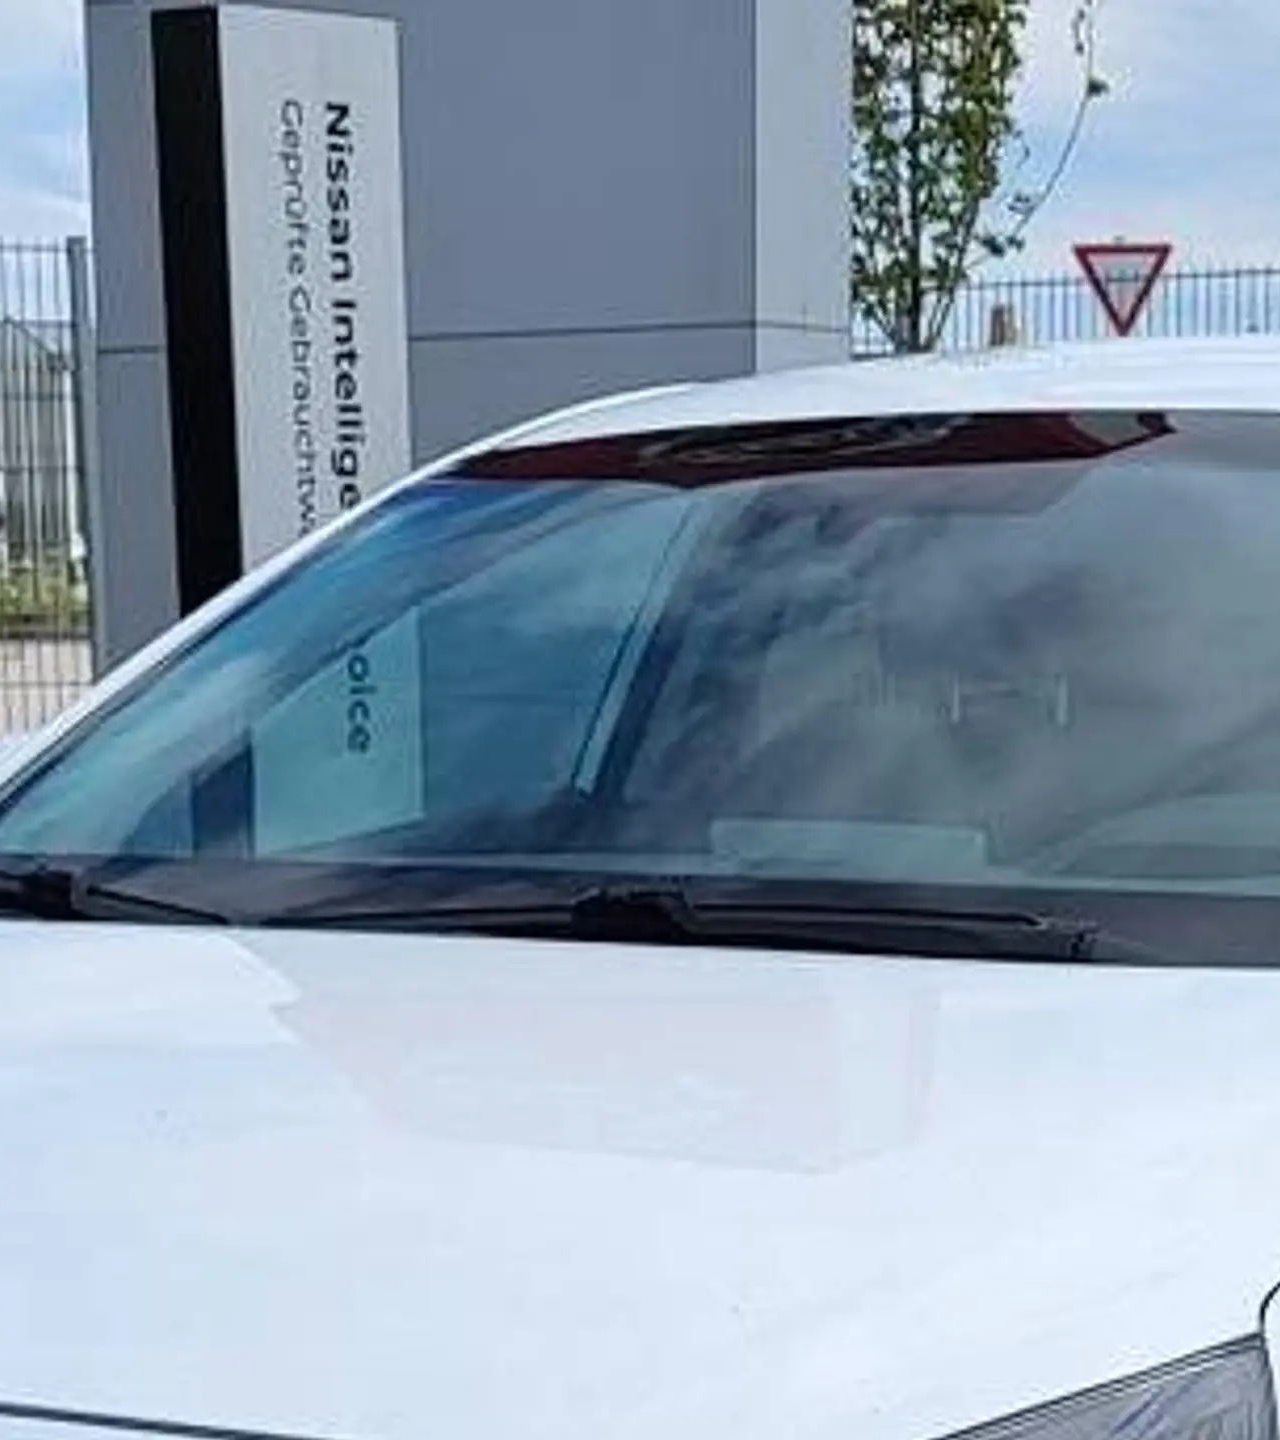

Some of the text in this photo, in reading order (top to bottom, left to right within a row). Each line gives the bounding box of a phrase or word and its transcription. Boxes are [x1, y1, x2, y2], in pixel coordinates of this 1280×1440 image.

[278, 99, 317, 537] Geprüfte Gebrauchtw
[325, 102, 378, 753] Nissan Intellige oice
